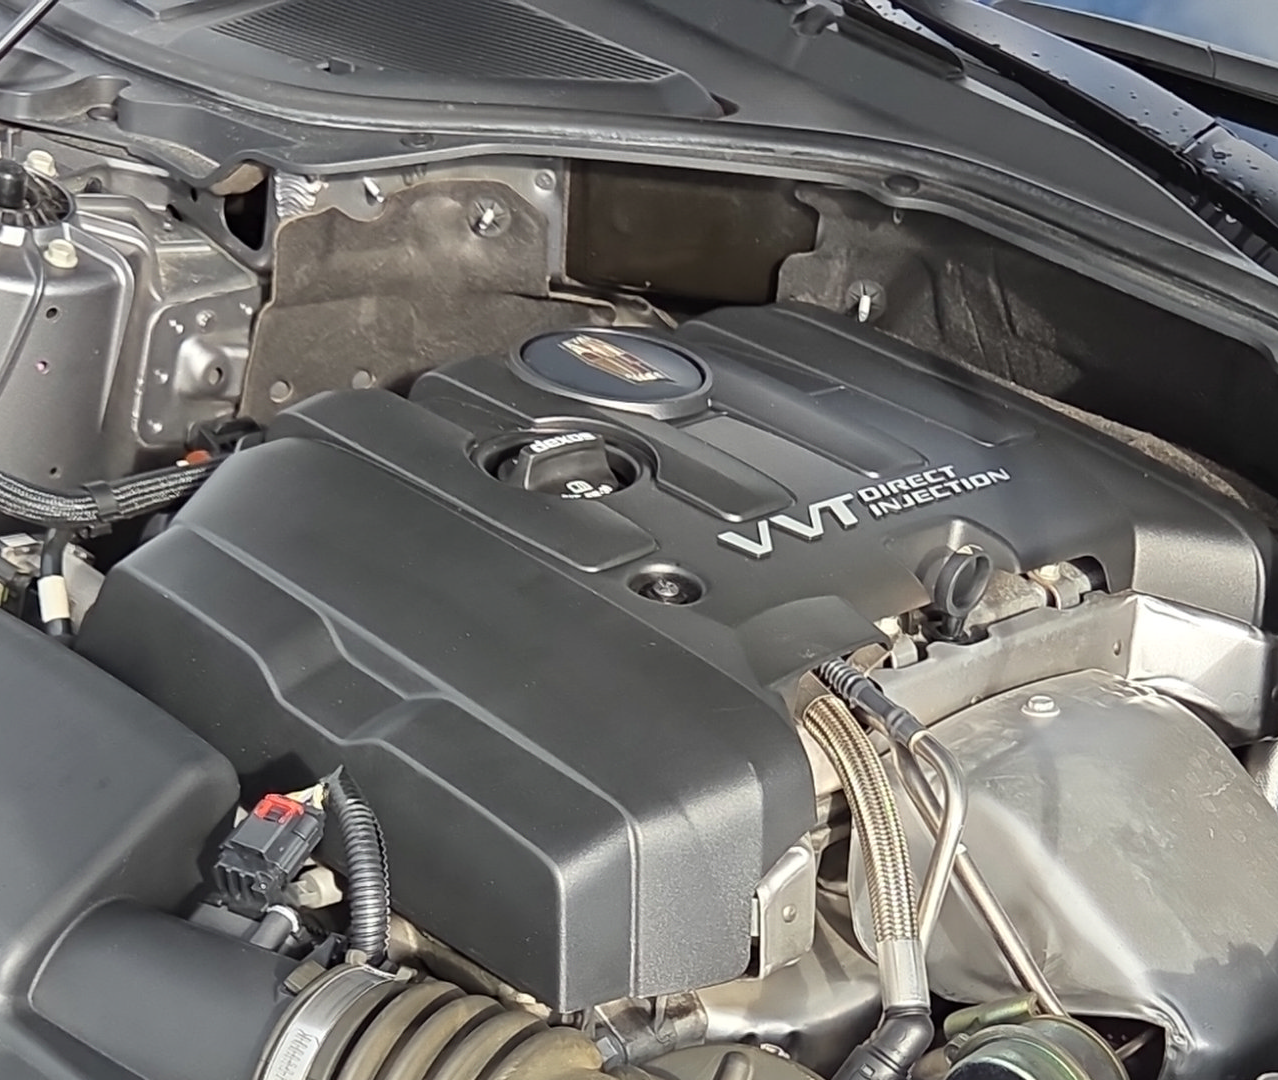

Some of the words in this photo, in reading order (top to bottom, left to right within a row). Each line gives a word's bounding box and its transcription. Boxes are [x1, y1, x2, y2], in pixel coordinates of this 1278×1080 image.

[529, 431, 597, 453] dexos
[857, 464, 955, 503] DIRECT
[868, 467, 1011, 519] INJECTION
[717, 493, 859, 558] VVT
